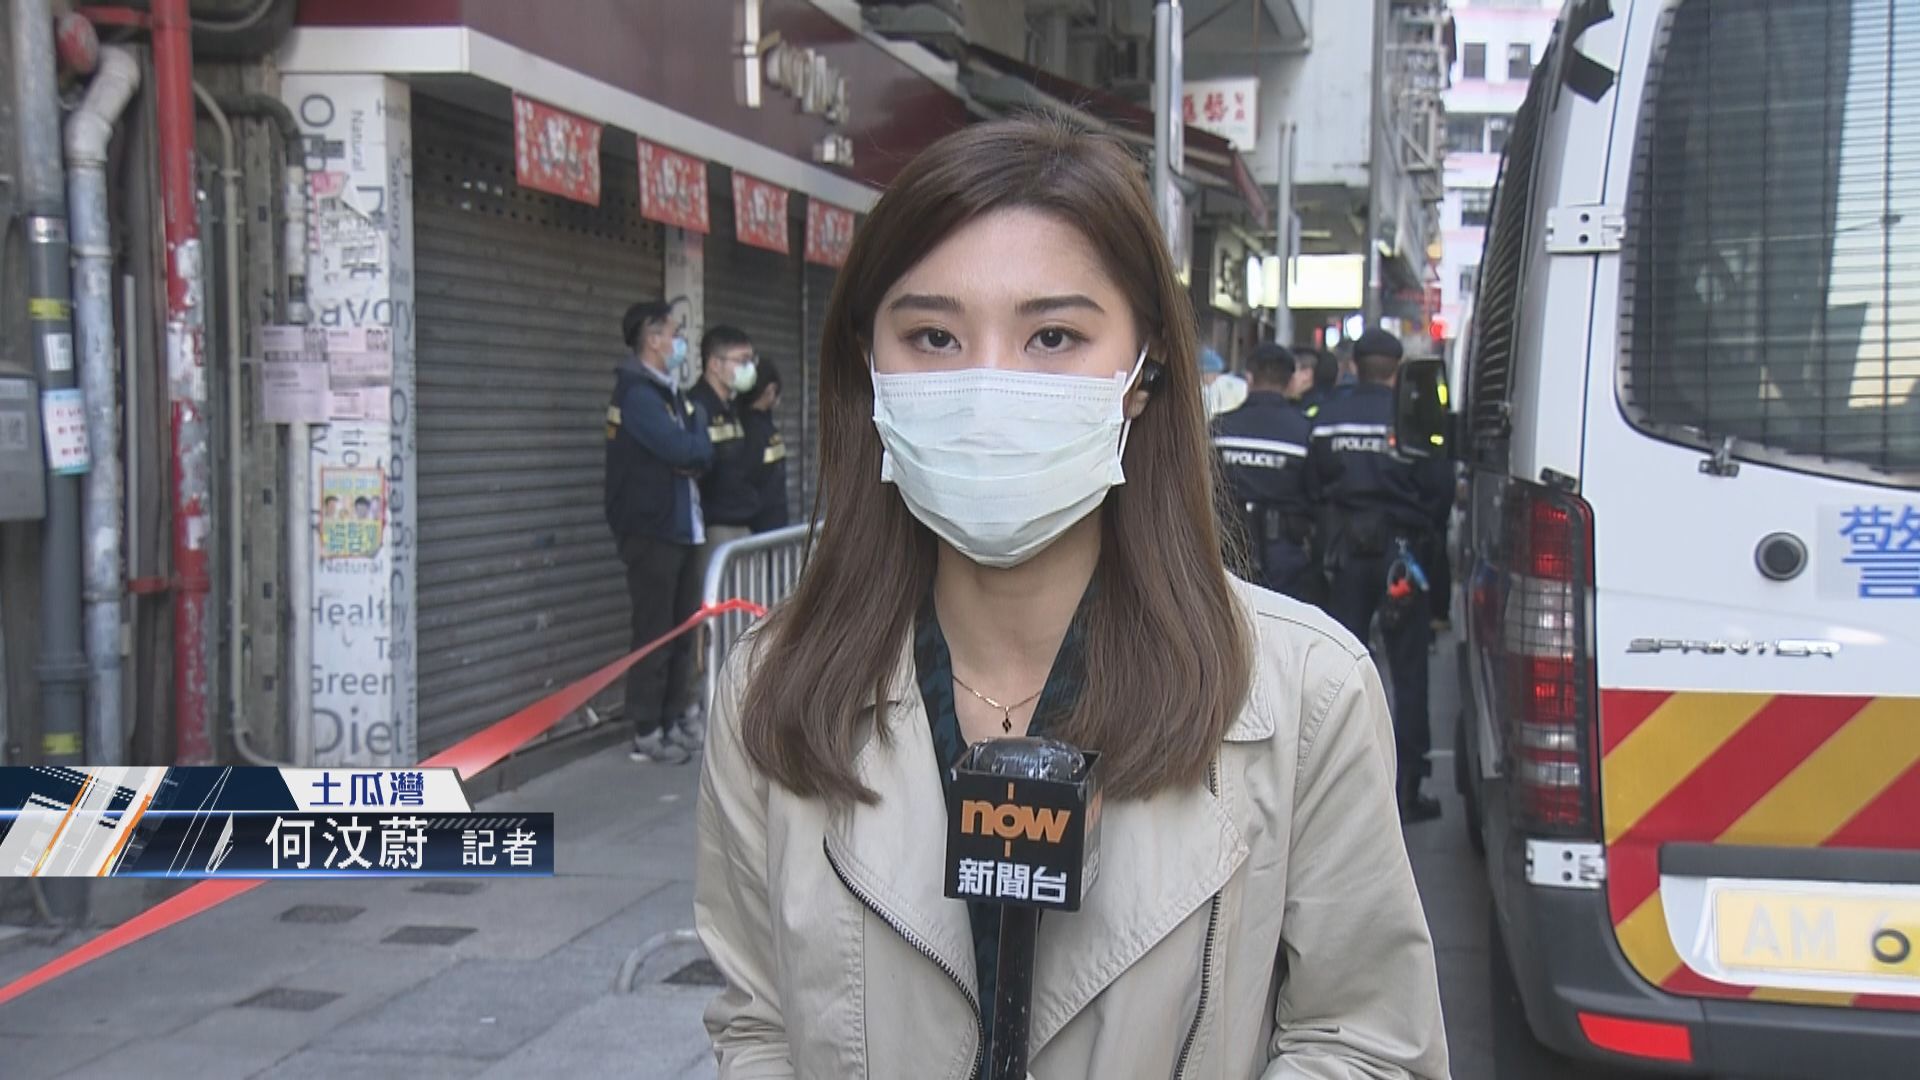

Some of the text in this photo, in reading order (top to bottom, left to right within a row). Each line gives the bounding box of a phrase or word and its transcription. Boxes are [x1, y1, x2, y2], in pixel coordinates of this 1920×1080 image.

[351, 110, 366, 172] Natural
[1839, 505, 1920, 599] 警
[1626, 638, 1842, 659] SPRINTER
[313, 707, 402, 756] Diet
[960, 797, 1071, 846] now
[957, 857, 1068, 904] 新聞台
[1743, 903, 1837, 961] AM
